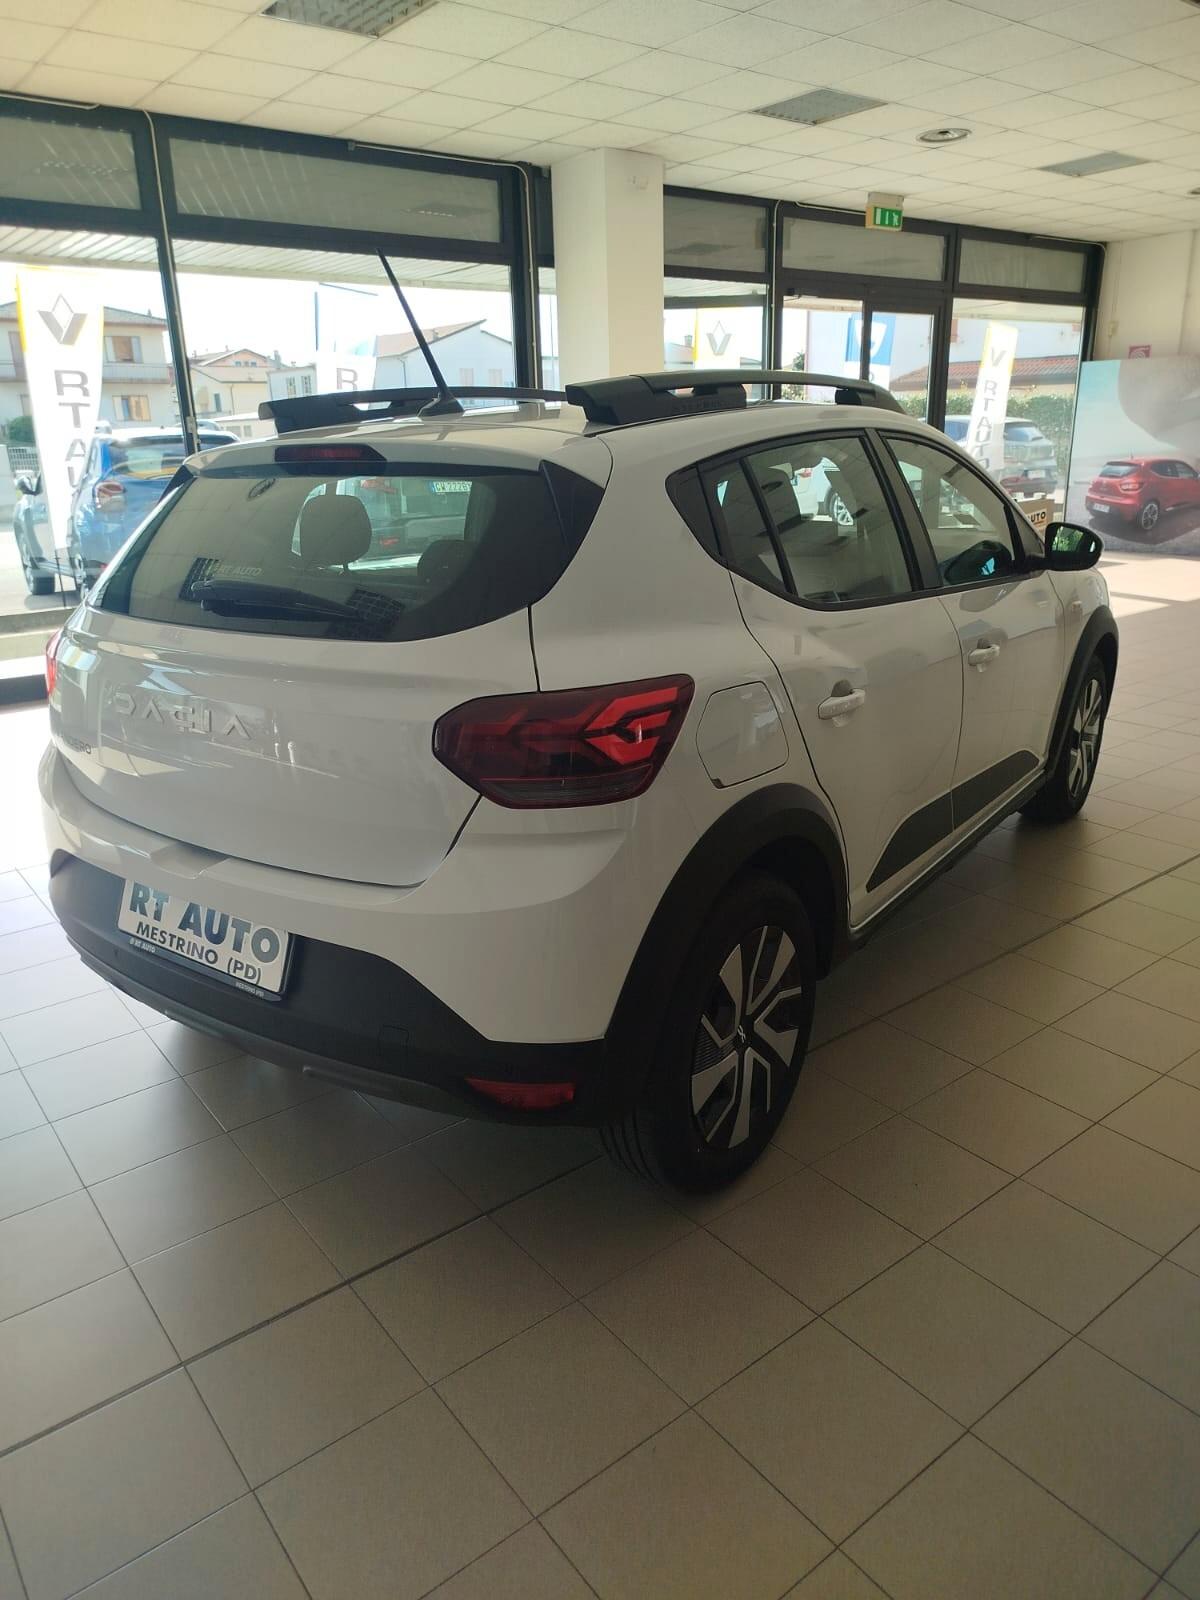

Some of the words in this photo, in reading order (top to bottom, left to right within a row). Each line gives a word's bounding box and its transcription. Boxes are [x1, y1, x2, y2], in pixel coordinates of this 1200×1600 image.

[129, 882, 169, 921] RT
[178, 901, 280, 964] AUTO
[137, 922, 218, 965] MESTRINO
[227, 956, 263, 985] (PD)
